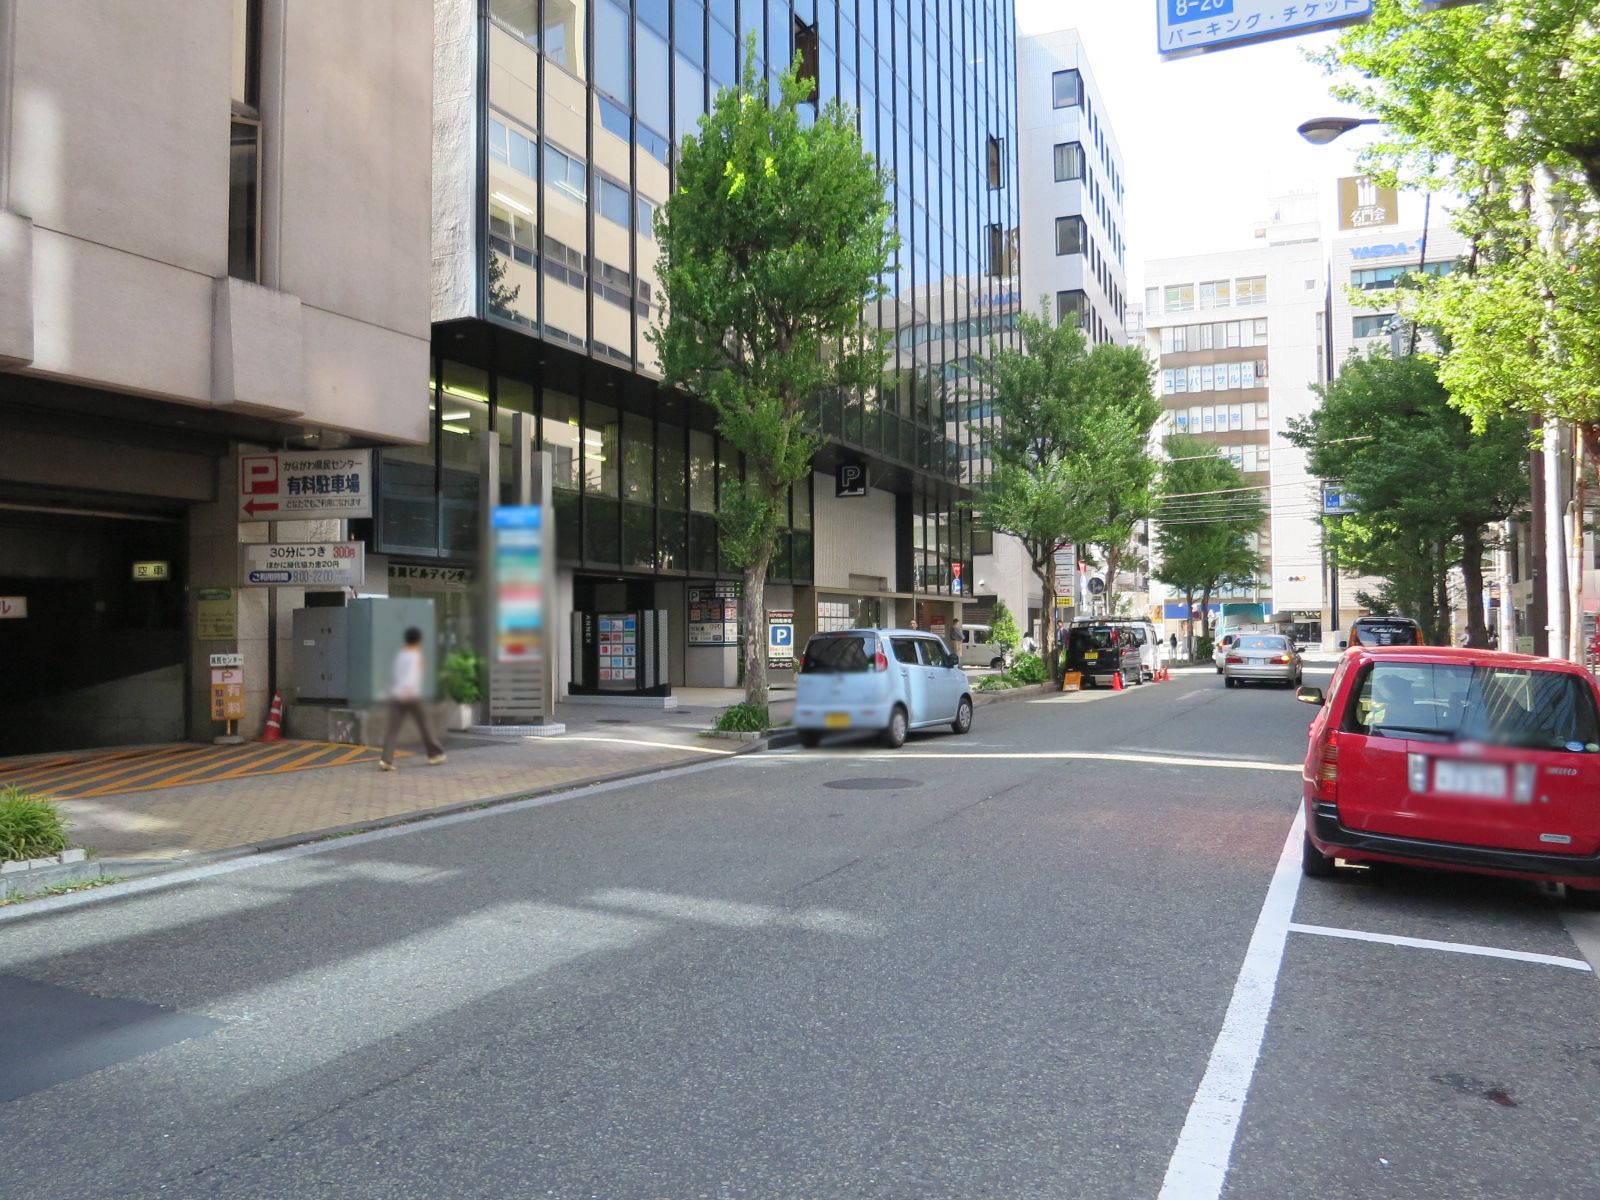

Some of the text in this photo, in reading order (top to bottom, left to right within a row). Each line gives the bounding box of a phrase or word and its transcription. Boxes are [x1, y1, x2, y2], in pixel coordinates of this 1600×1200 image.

[283, 460, 362, 472] かながわ県民センター
[841, 466, 860, 487] P
[287, 473, 360, 495] 有料駐車場
[137, 565, 164, 576] 空車
[776, 628, 787, 644] P
[221, 671, 234, 682] P
